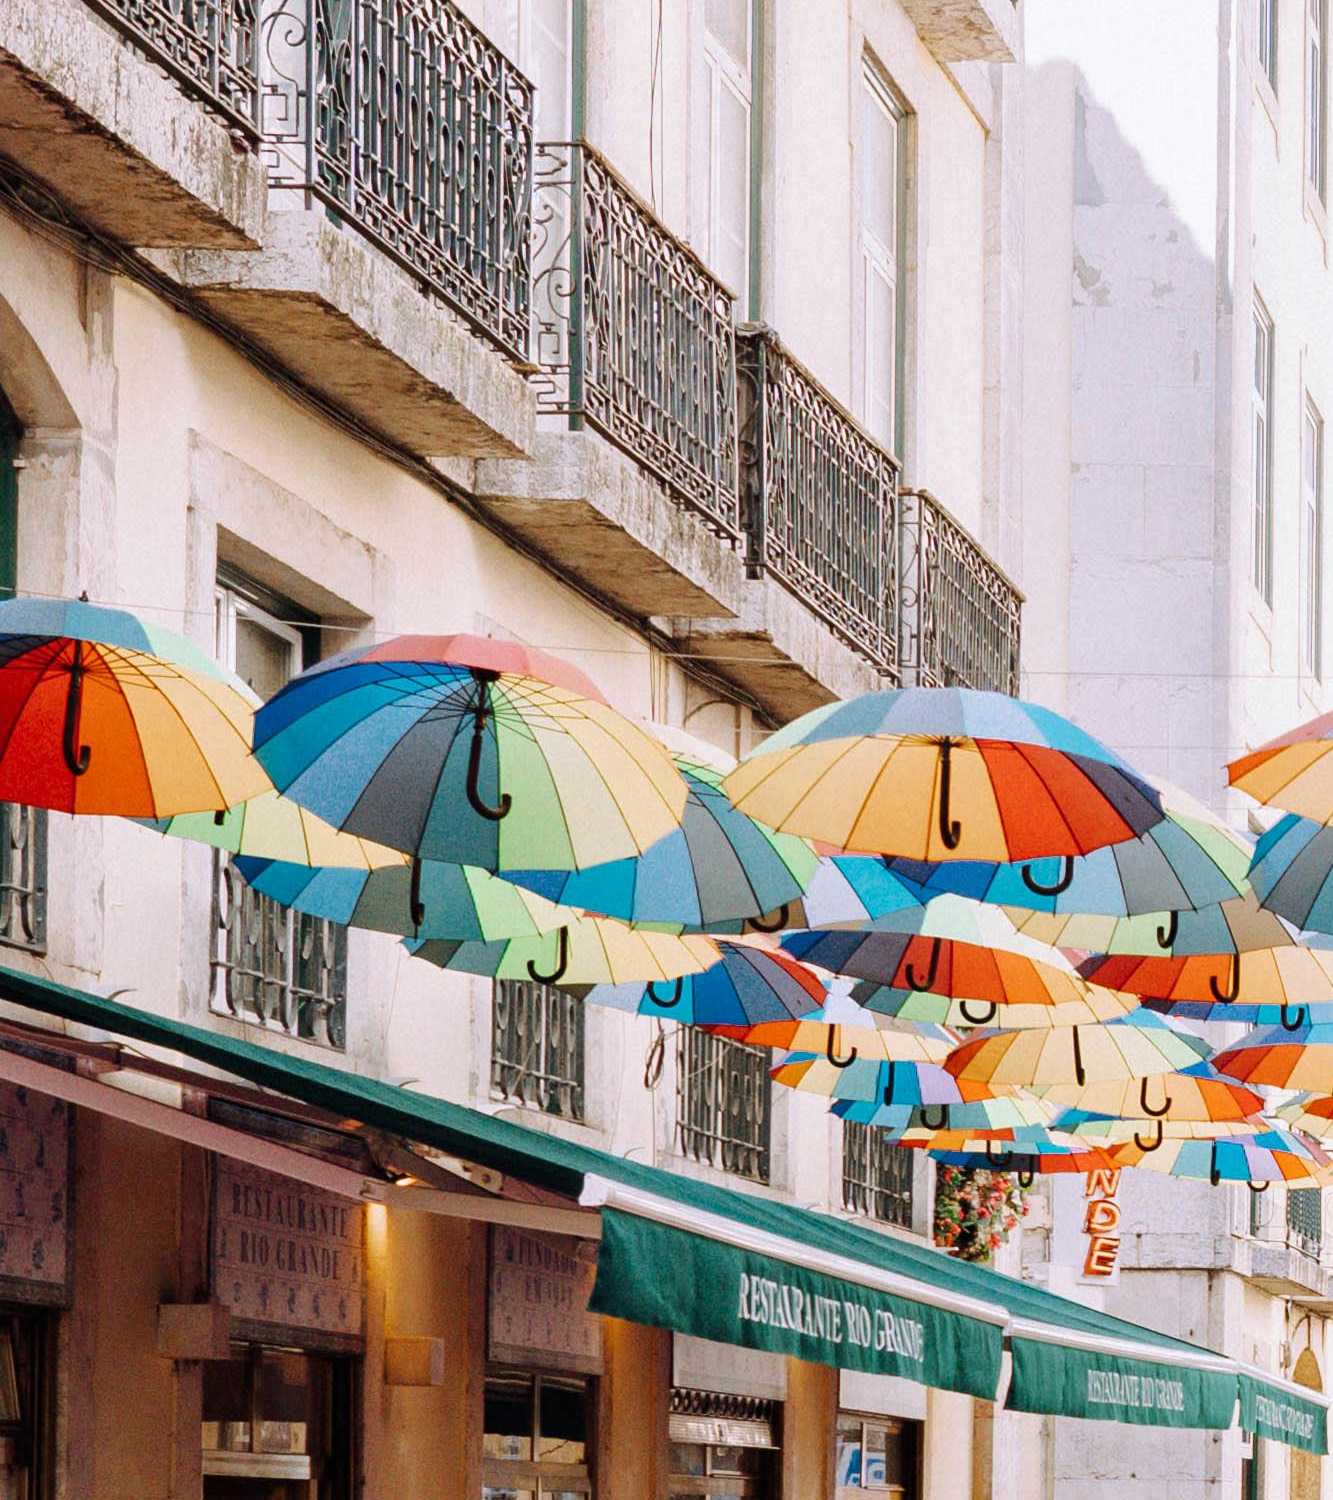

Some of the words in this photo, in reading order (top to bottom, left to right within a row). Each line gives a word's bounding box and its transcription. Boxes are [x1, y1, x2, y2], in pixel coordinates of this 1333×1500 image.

[233, 1182, 348, 1238] RESTAURANTE
[241, 1231, 270, 1268] RIO
[276, 1237, 339, 1280] GRANDE
[738, 1273, 842, 1343] RESTAURANTE
[844, 1301, 871, 1348] RIO
[874, 1309, 924, 1363] GRANDE
